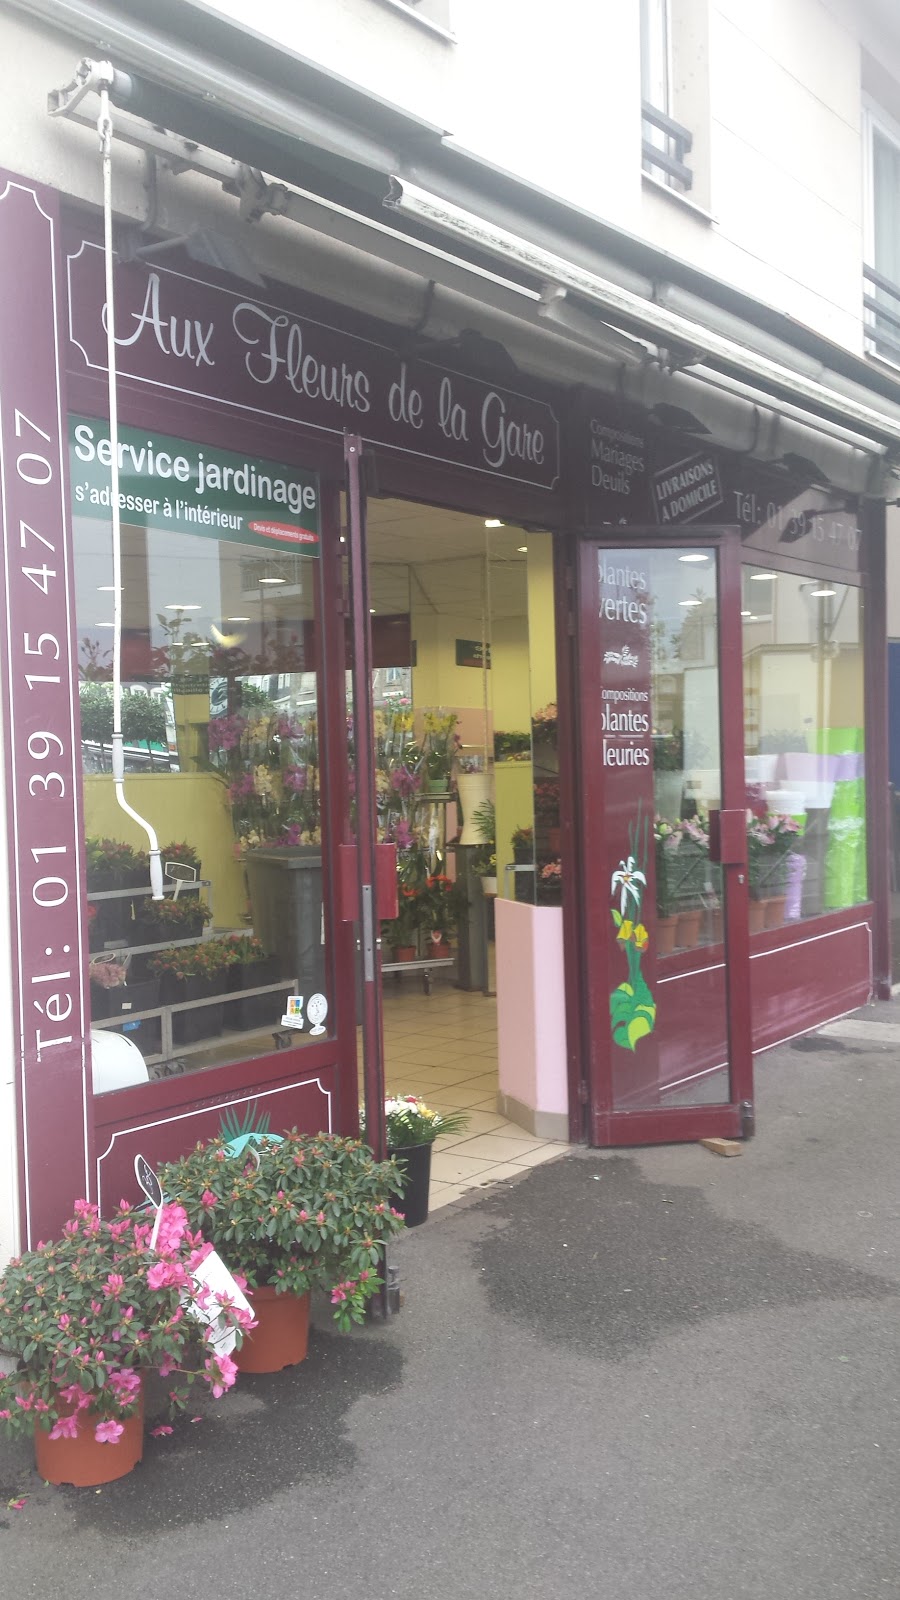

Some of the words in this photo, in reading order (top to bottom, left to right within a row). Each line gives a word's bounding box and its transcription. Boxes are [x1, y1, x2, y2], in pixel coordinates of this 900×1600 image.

[102, 273, 214, 366] Aux
[232, 302, 370, 412] Fleurs
[388, 361, 423, 429] de
[438, 377, 469, 442] la
[481, 392, 545, 468] Gare
[14, 407, 52, 486] 07
[74, 424, 190, 482] Service
[195, 453, 316, 514] jardinage
[591, 437, 646, 476] Mariages
[591, 465, 632, 495] Deuils
[656, 463, 714, 500] LIVRAISONS
[670, 479, 718, 517] DOMICILE
[164, 497, 173, 518] à
[176, 499, 243, 531] l'intérieur
[19, 519, 57, 596] 47
[24, 632, 61, 691] 15
[601, 687, 649, 704] ompositions
[27, 730, 65, 798] 39
[603, 738, 650, 766] leuries
[31, 845, 69, 908] 01
